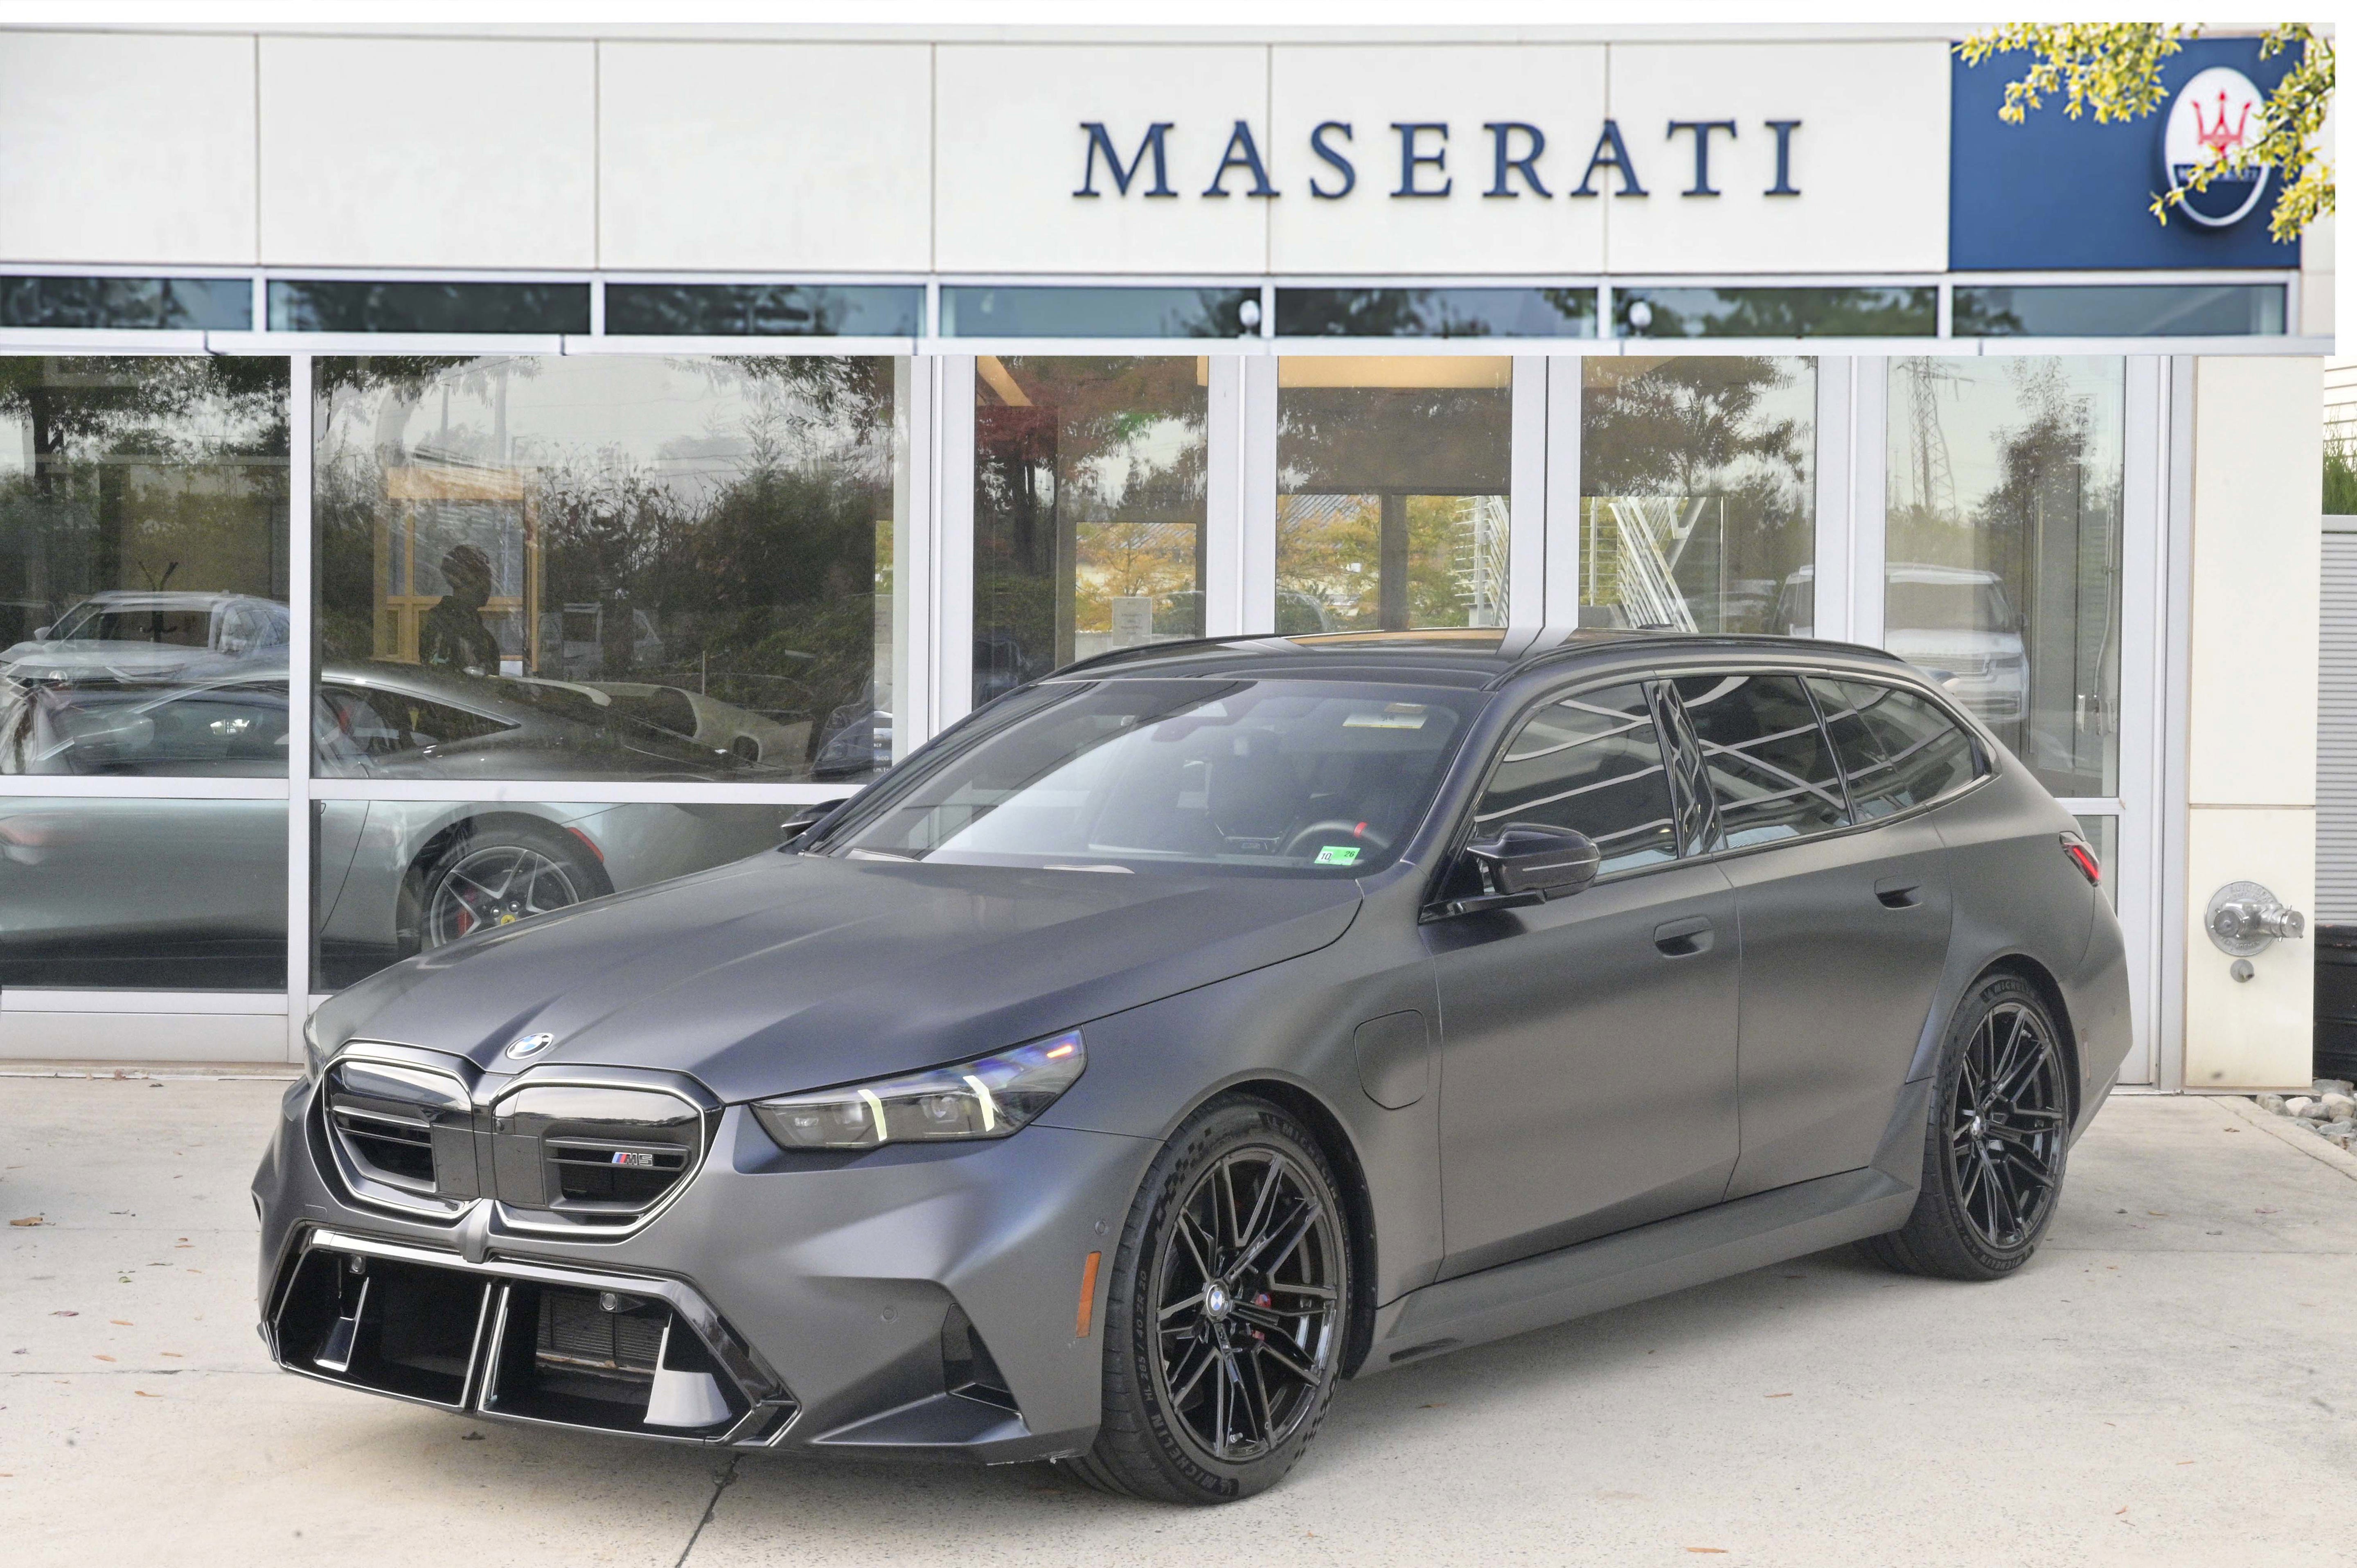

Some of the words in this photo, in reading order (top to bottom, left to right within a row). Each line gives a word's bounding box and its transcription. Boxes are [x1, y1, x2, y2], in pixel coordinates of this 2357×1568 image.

[1073, 120, 1802, 199] MASERATI
[623, 1152, 653, 1166] M5
[1139, 1270, 1147, 1291] 20
[1137, 1293, 1144, 1315] ZR
[1136, 1318, 1143, 1338] 40
[1138, 1356, 1148, 1380] 285
[1150, 1414, 1218, 1489] MICHELIN
